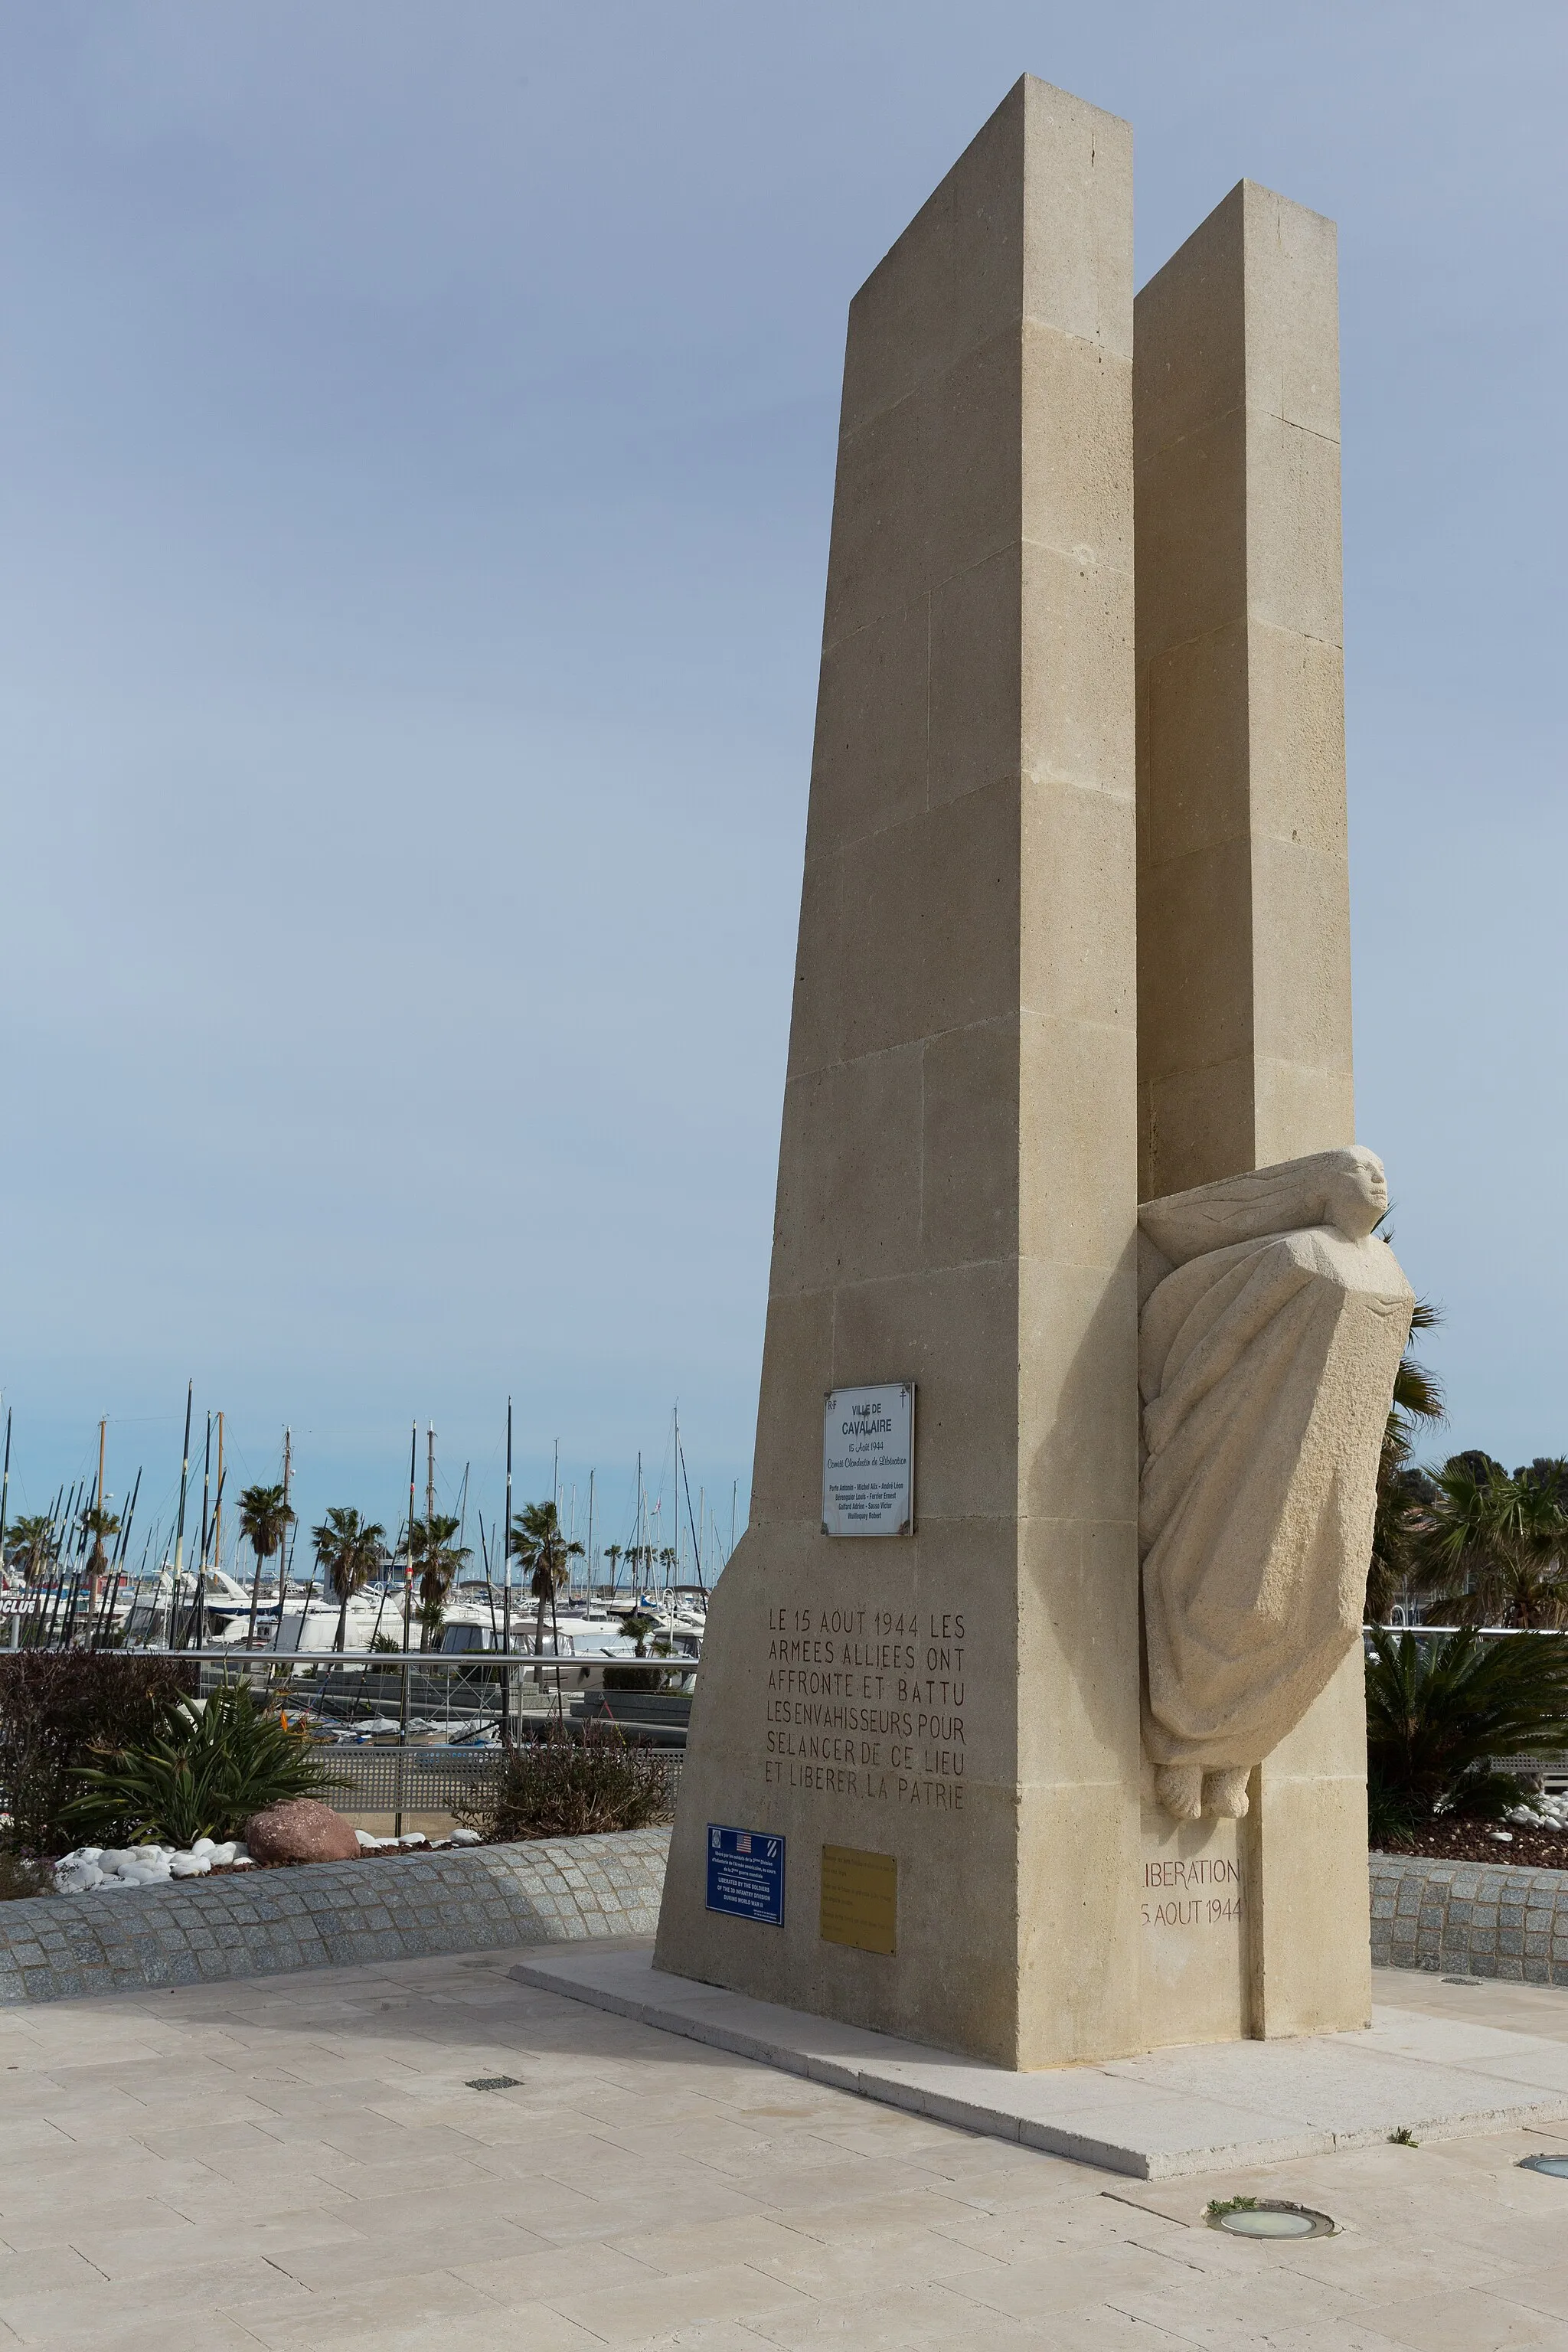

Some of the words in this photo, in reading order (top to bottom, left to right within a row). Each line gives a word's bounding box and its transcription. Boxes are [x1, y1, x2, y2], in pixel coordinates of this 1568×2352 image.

[852, 1404, 871, 1415] VILLE
[872, 1403, 881, 1413] DE
[842, 1419, 892, 1435] CAVALAIRE
[828, 1459, 843, 1468] Comité
[845, 1458, 871, 1468] Clandestin
[872, 1457, 877, 1465] de
[879, 1455, 906, 1466] Libération
[849, 1444, 854, 1452] 15
[871, 1442, 884, 1451] 1944
[769, 1609, 786, 1631] LE
[795, 1610, 810, 1632] 15
[820, 1611, 865, 1634] AOUT
[875, 1612, 918, 1637] 1944
[931, 1615, 965, 1638] LES
[769, 1640, 834, 1664] ARMEES
[843, 1643, 915, 1669] ALLIEES
[927, 1648, 964, 1671] ONT
[769, 1670, 853, 1697] AFFRONTE
[864, 1676, 884, 1699] ET
[898, 1679, 964, 1706] BATTU
[767, 1700, 791, 1723] LES
[795, 1703, 913, 1739] ENVAHISSEURS
[919, 1713, 966, 1746] POUR
[766, 1730, 856, 1766] S'ELANCER
[861, 1742, 880, 1766] DE
[891, 1746, 913, 1769] CE
[926, 1750, 964, 1776] LIEU
[766, 1761, 782, 1783] ET
[790, 1763, 857, 1795] LIBERER
[867, 1774, 887, 1799] LA
[899, 1778, 963, 1810] PATRIE
[718, 1877, 737, 1886] LIBERATED
[752, 1884, 769, 1893] SOLDIERS
[1142, 1859, 1240, 1890] IBERATION
[736, 1889, 753, 1897] INFANTRY
[1155, 1900, 1202, 1926] AOUT
[1207, 1897, 1242, 1923] 1944
